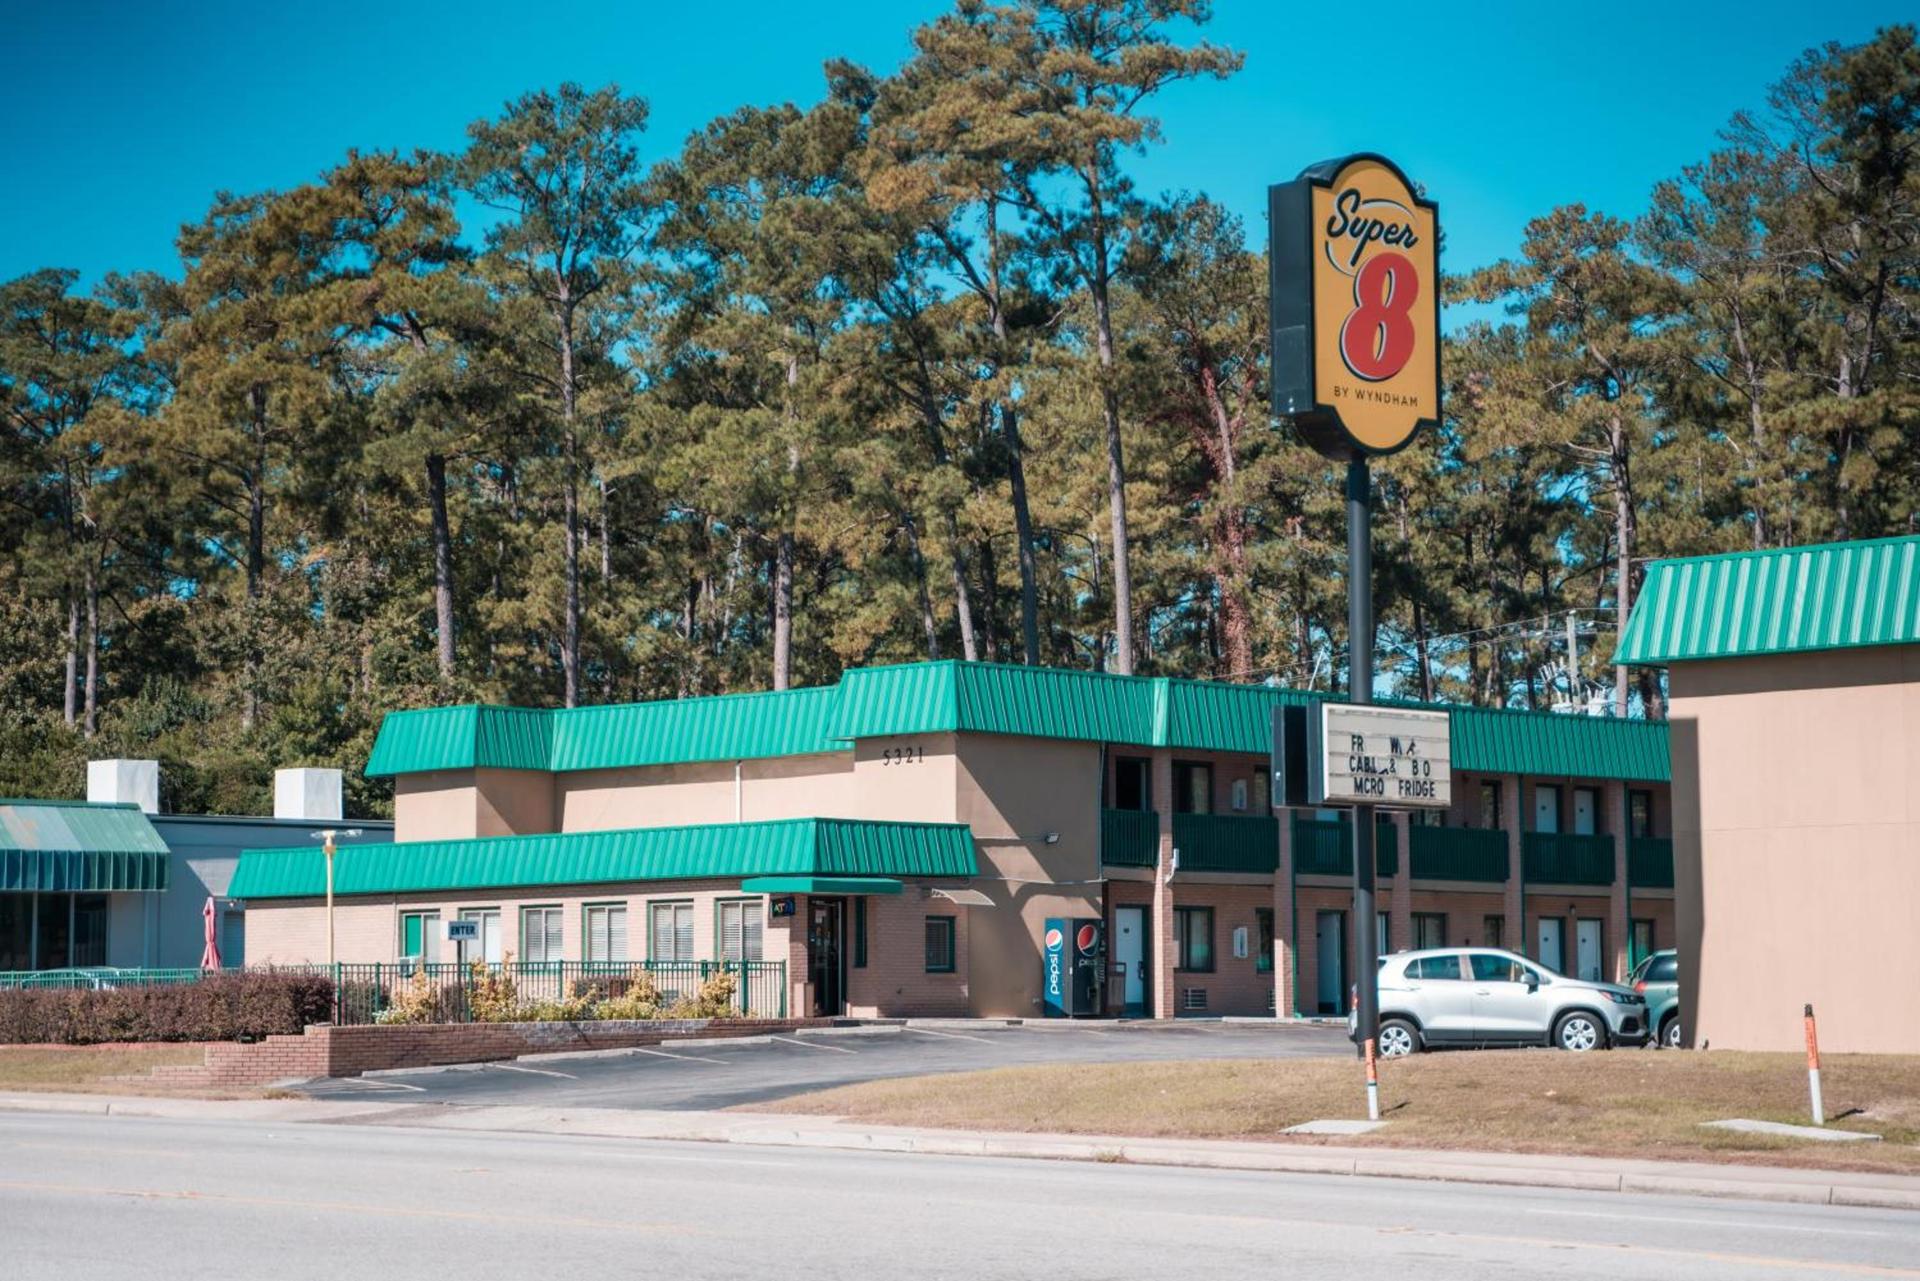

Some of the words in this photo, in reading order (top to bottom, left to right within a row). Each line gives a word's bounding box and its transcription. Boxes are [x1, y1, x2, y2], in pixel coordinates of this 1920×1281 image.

[1326, 188, 1418, 266] Super
[1340, 252, 1419, 382] 8
[1334, 386, 1348, 397] BY
[1355, 388, 1418, 407] WYNDHAM
[883, 747, 923, 766] 5321
[1353, 777, 1385, 795] MCRO
[1399, 779, 1435, 797] FRIDGE
[450, 925, 476, 936] ENTER
[1049, 953, 1061, 996] pepsi
